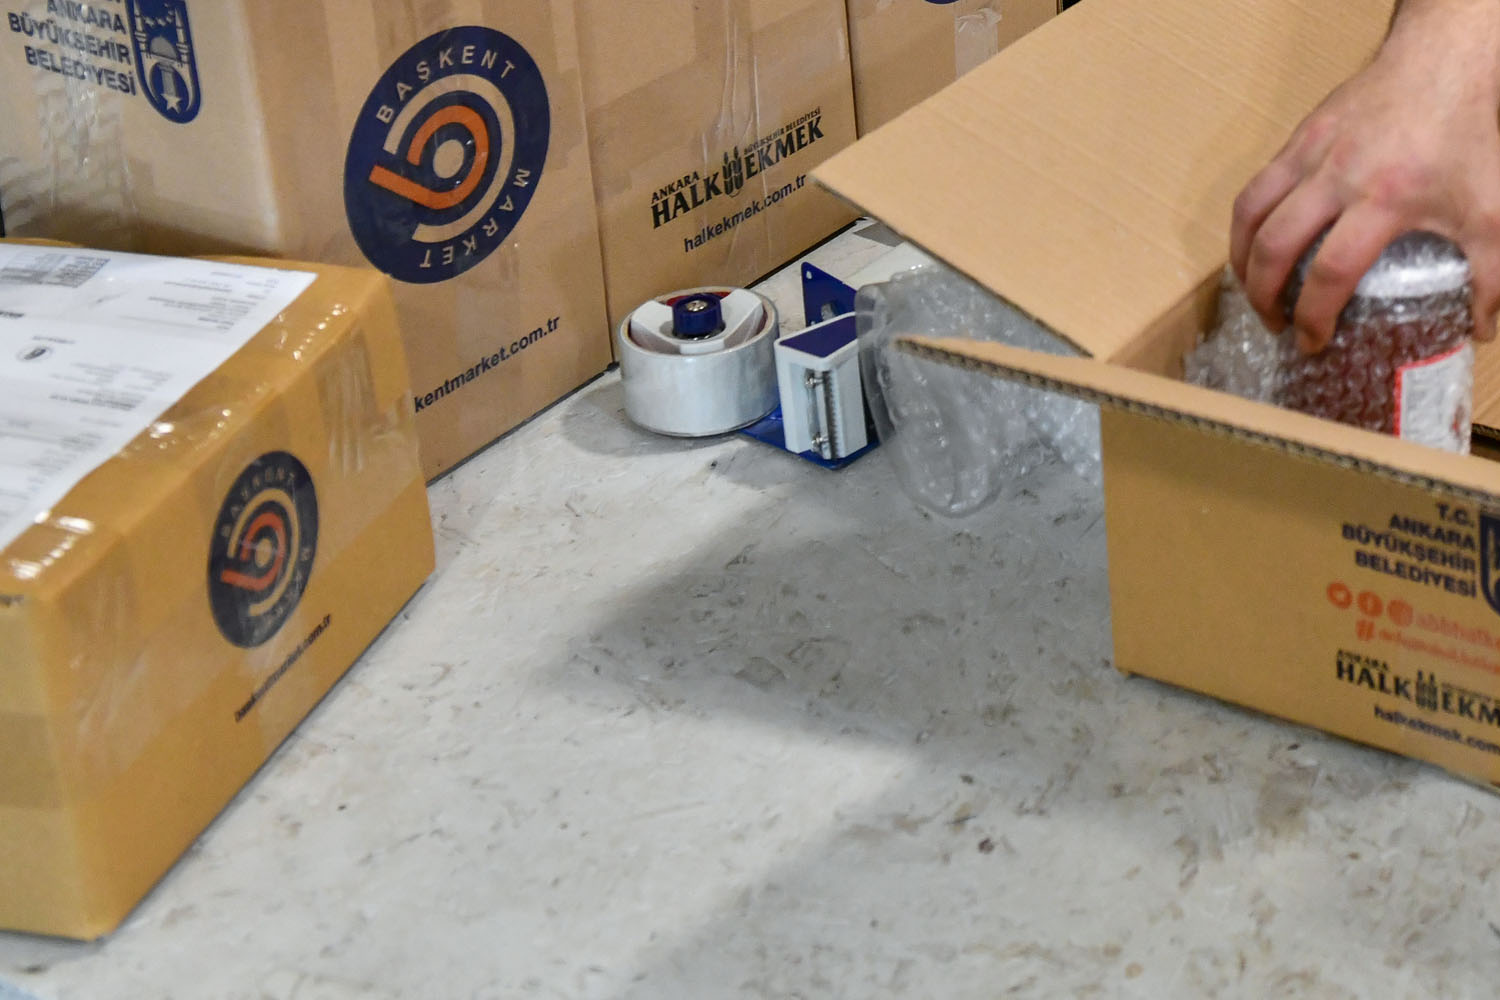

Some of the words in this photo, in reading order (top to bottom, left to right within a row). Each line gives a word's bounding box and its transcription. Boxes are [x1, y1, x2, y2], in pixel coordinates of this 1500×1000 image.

[375, 43, 516, 125] BAŞKENT
[650, 171, 723, 229] HALK
[744, 116, 824, 180] EKMEK
[651, 171, 700, 204] ANKARA
[419, 168, 531, 269] MARKET
[684, 174, 806, 252] halkekmek.com.tr
[414, 314, 561, 414] kentmarket.com.tr
[1389, 514, 1476, 549] ANKARA
[1336, 659, 1411, 700] HALK
